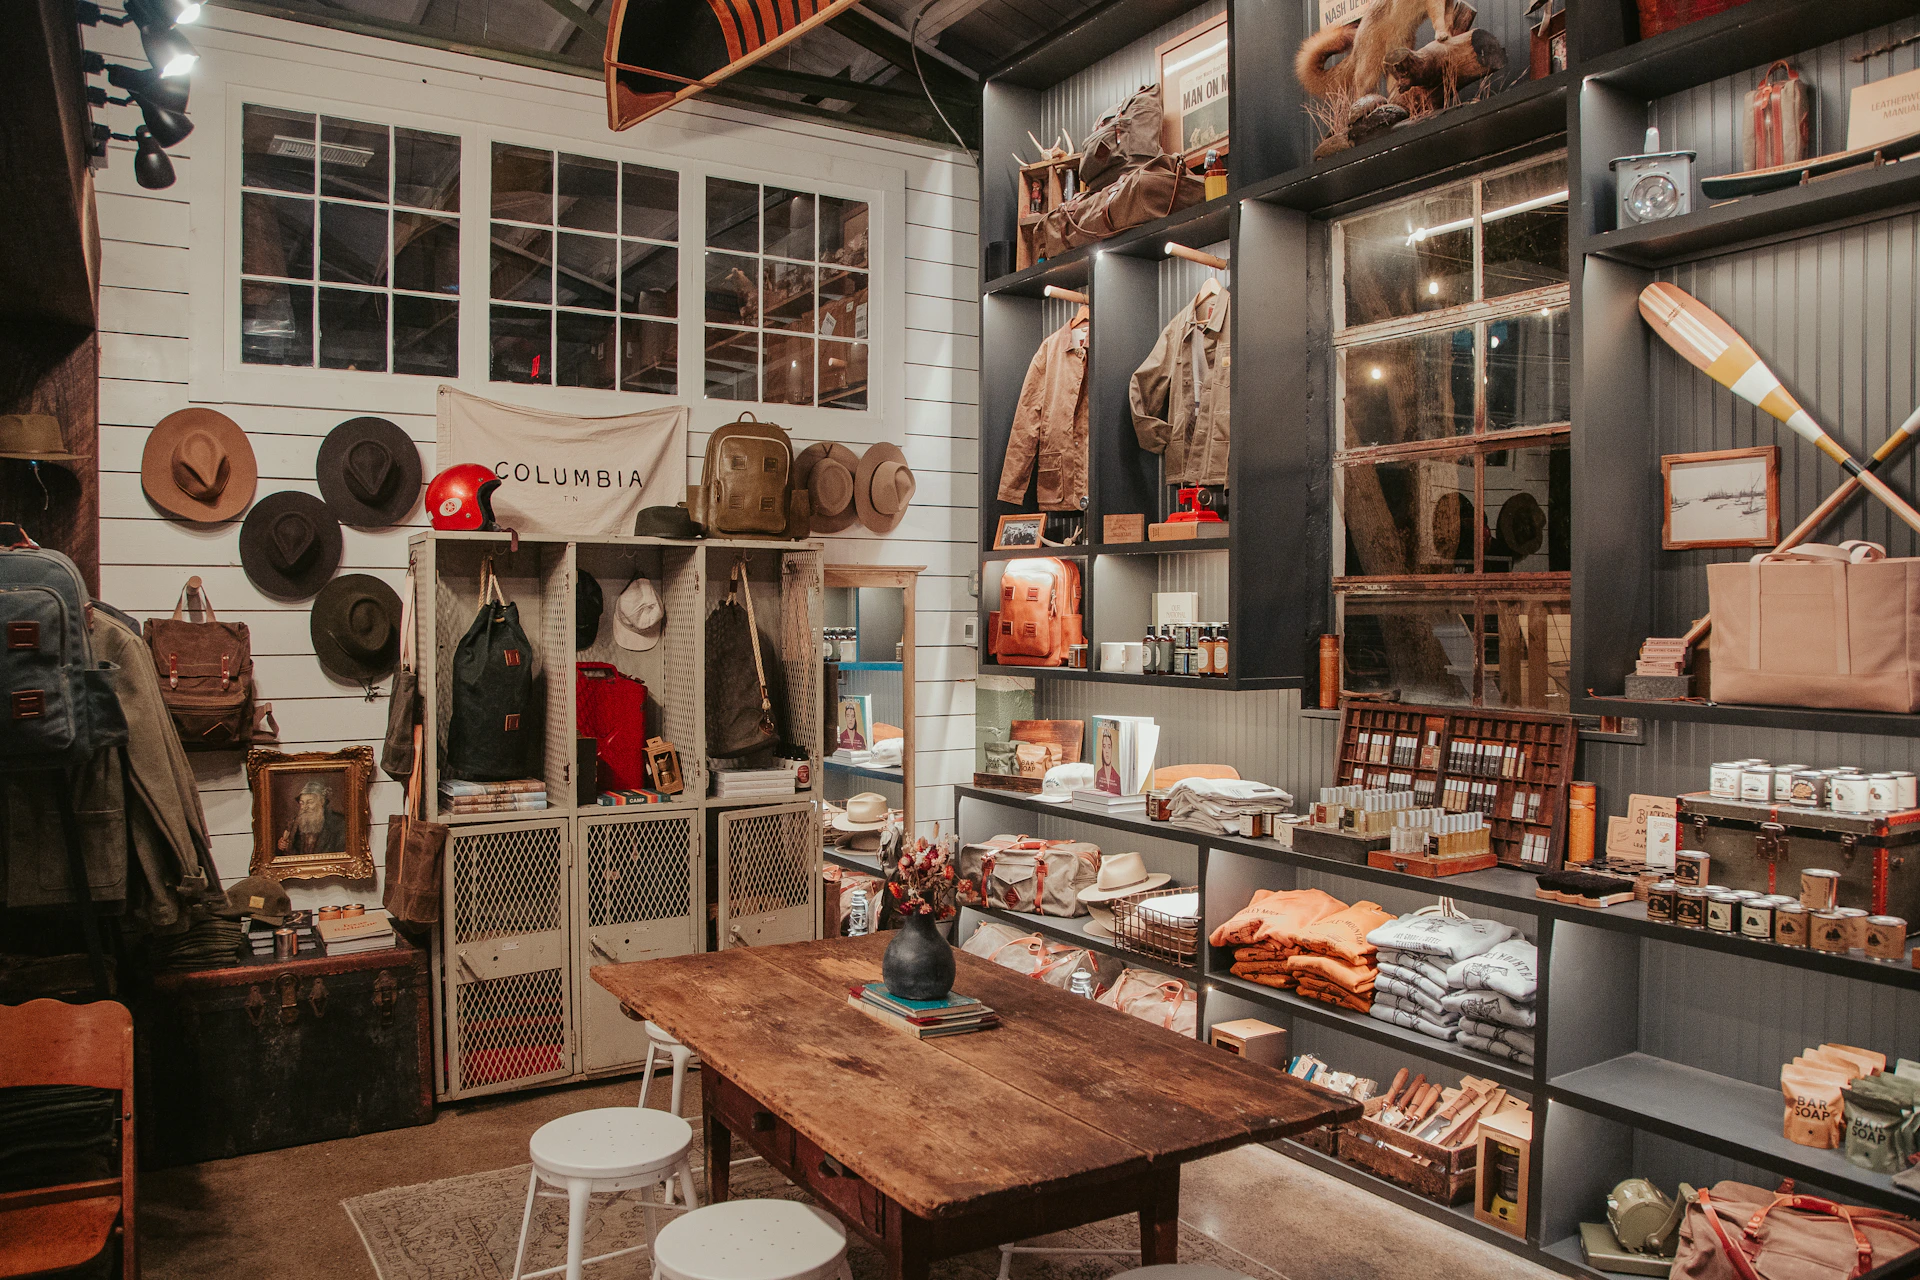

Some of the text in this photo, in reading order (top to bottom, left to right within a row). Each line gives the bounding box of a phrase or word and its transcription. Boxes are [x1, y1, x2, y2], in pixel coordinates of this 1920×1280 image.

[1325, 1, 1346, 25] NASH
[1183, 85, 1203, 111] MAN
[1206, 77, 1219, 99] ON
[495, 461, 643, 488] COLUMBIA
[1166, 611, 1186, 619] NATIONAL
[1171, 604, 1181, 612] OUR
[1395, 940, 1422, 950] TENNESSEE
[1797, 1096, 1828, 1110] BAR
[1795, 1106, 1831, 1121] SOAP
[1855, 1117, 1883, 1134] BAR
[1852, 1126, 1886, 1144] SOAP
